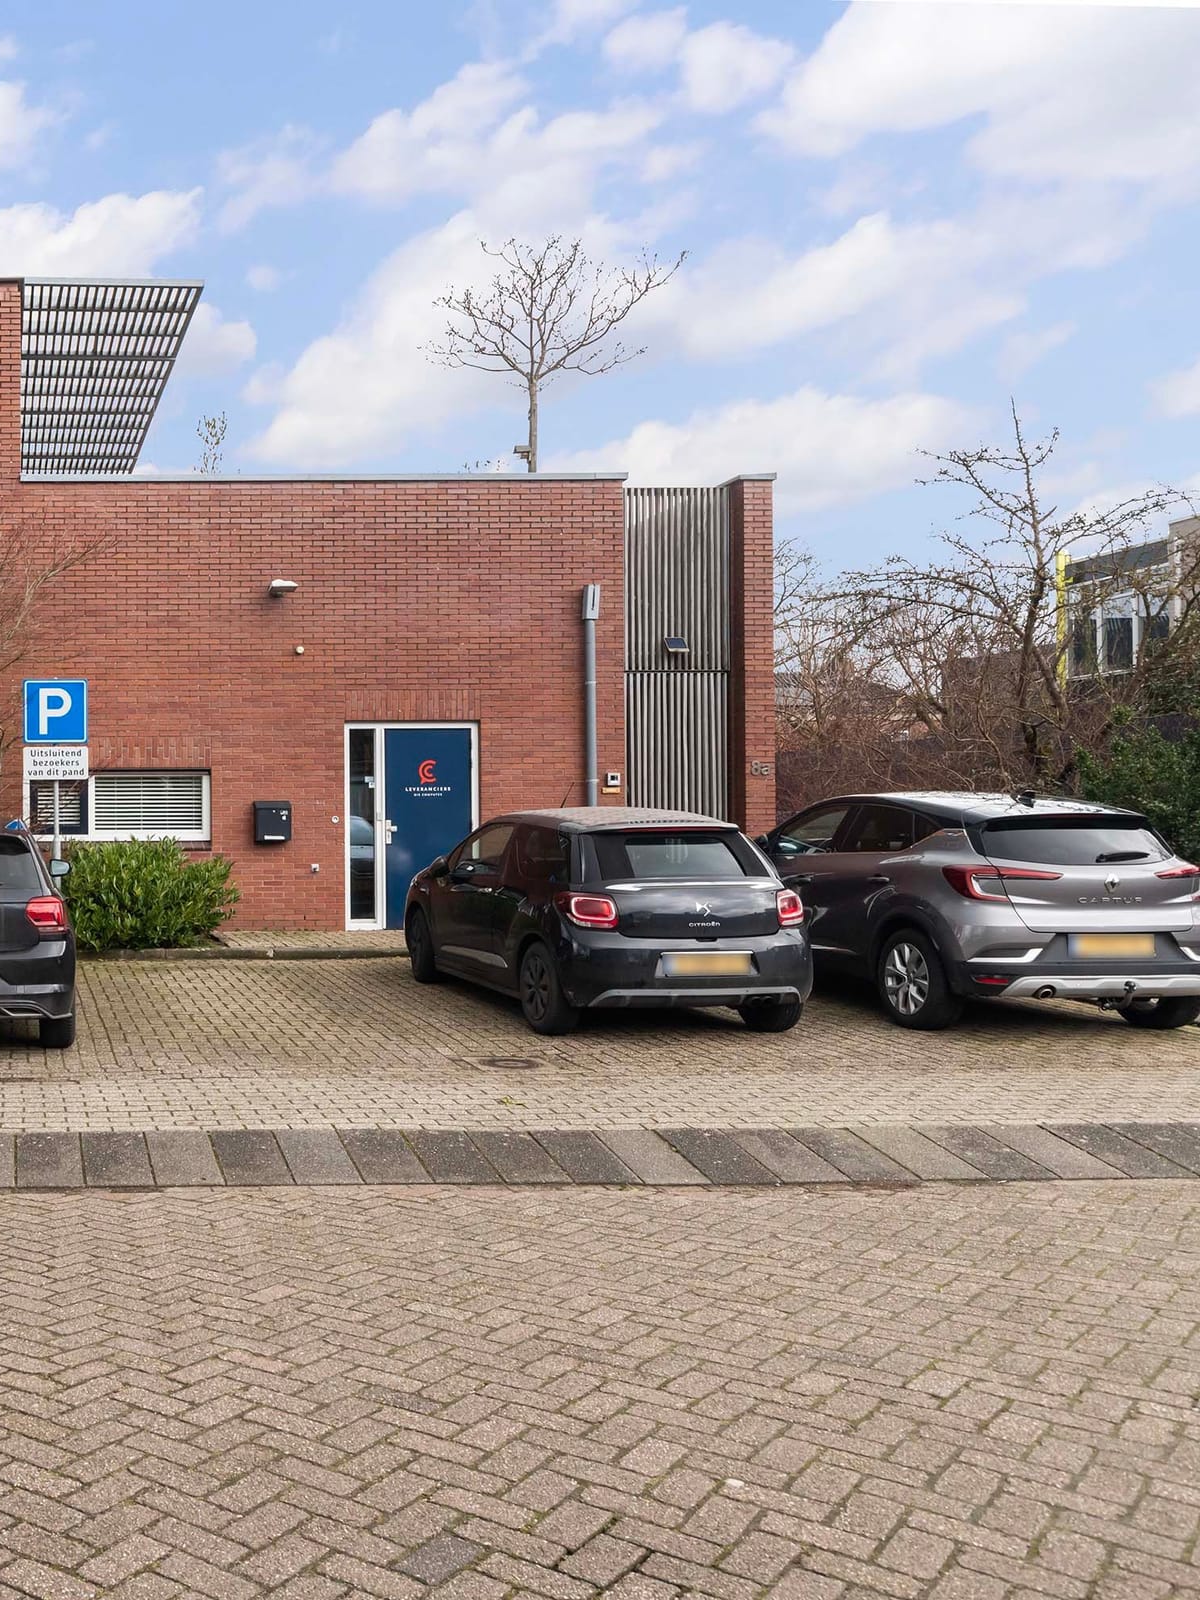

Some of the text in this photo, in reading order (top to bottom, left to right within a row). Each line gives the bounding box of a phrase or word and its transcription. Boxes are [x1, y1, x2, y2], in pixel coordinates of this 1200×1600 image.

[38, 687, 72, 735] P
[30, 749, 82, 757] Uitsluitend
[32, 759, 80, 767] bezoekers
[46, 768, 59, 776] dit
[62, 768, 85, 777] pand
[1079, 896, 1143, 904] CAPTUR
[688, 920, 721, 928] CITROËN
